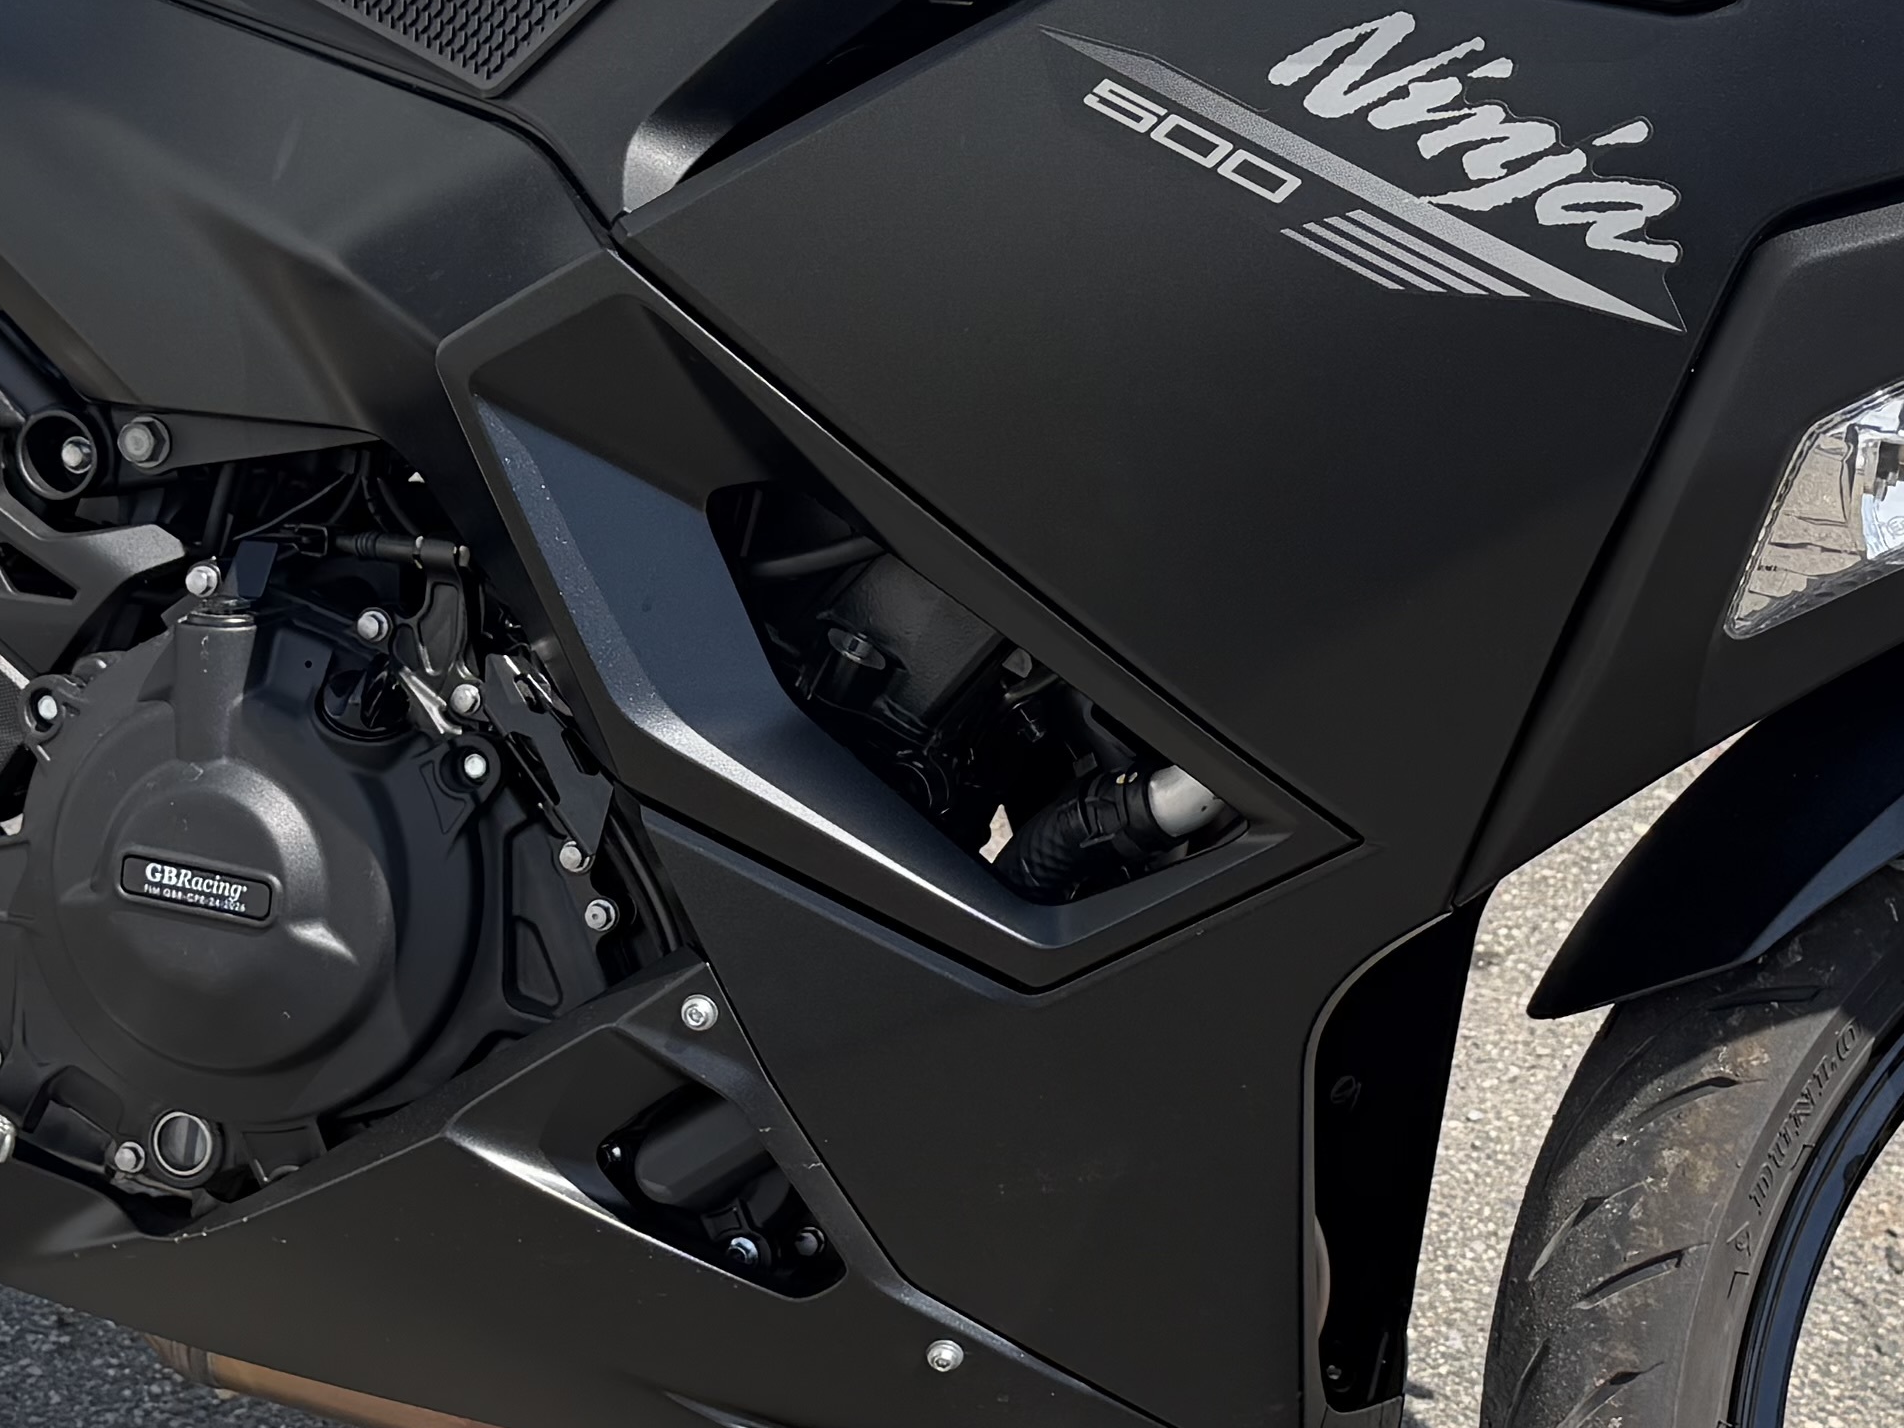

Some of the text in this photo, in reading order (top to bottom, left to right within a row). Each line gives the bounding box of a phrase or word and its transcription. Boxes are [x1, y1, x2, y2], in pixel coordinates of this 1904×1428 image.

[1083, 78, 1302, 204] 500
[1268, 10, 1681, 263] Ninja
[145, 862, 243, 901] GBRacing
